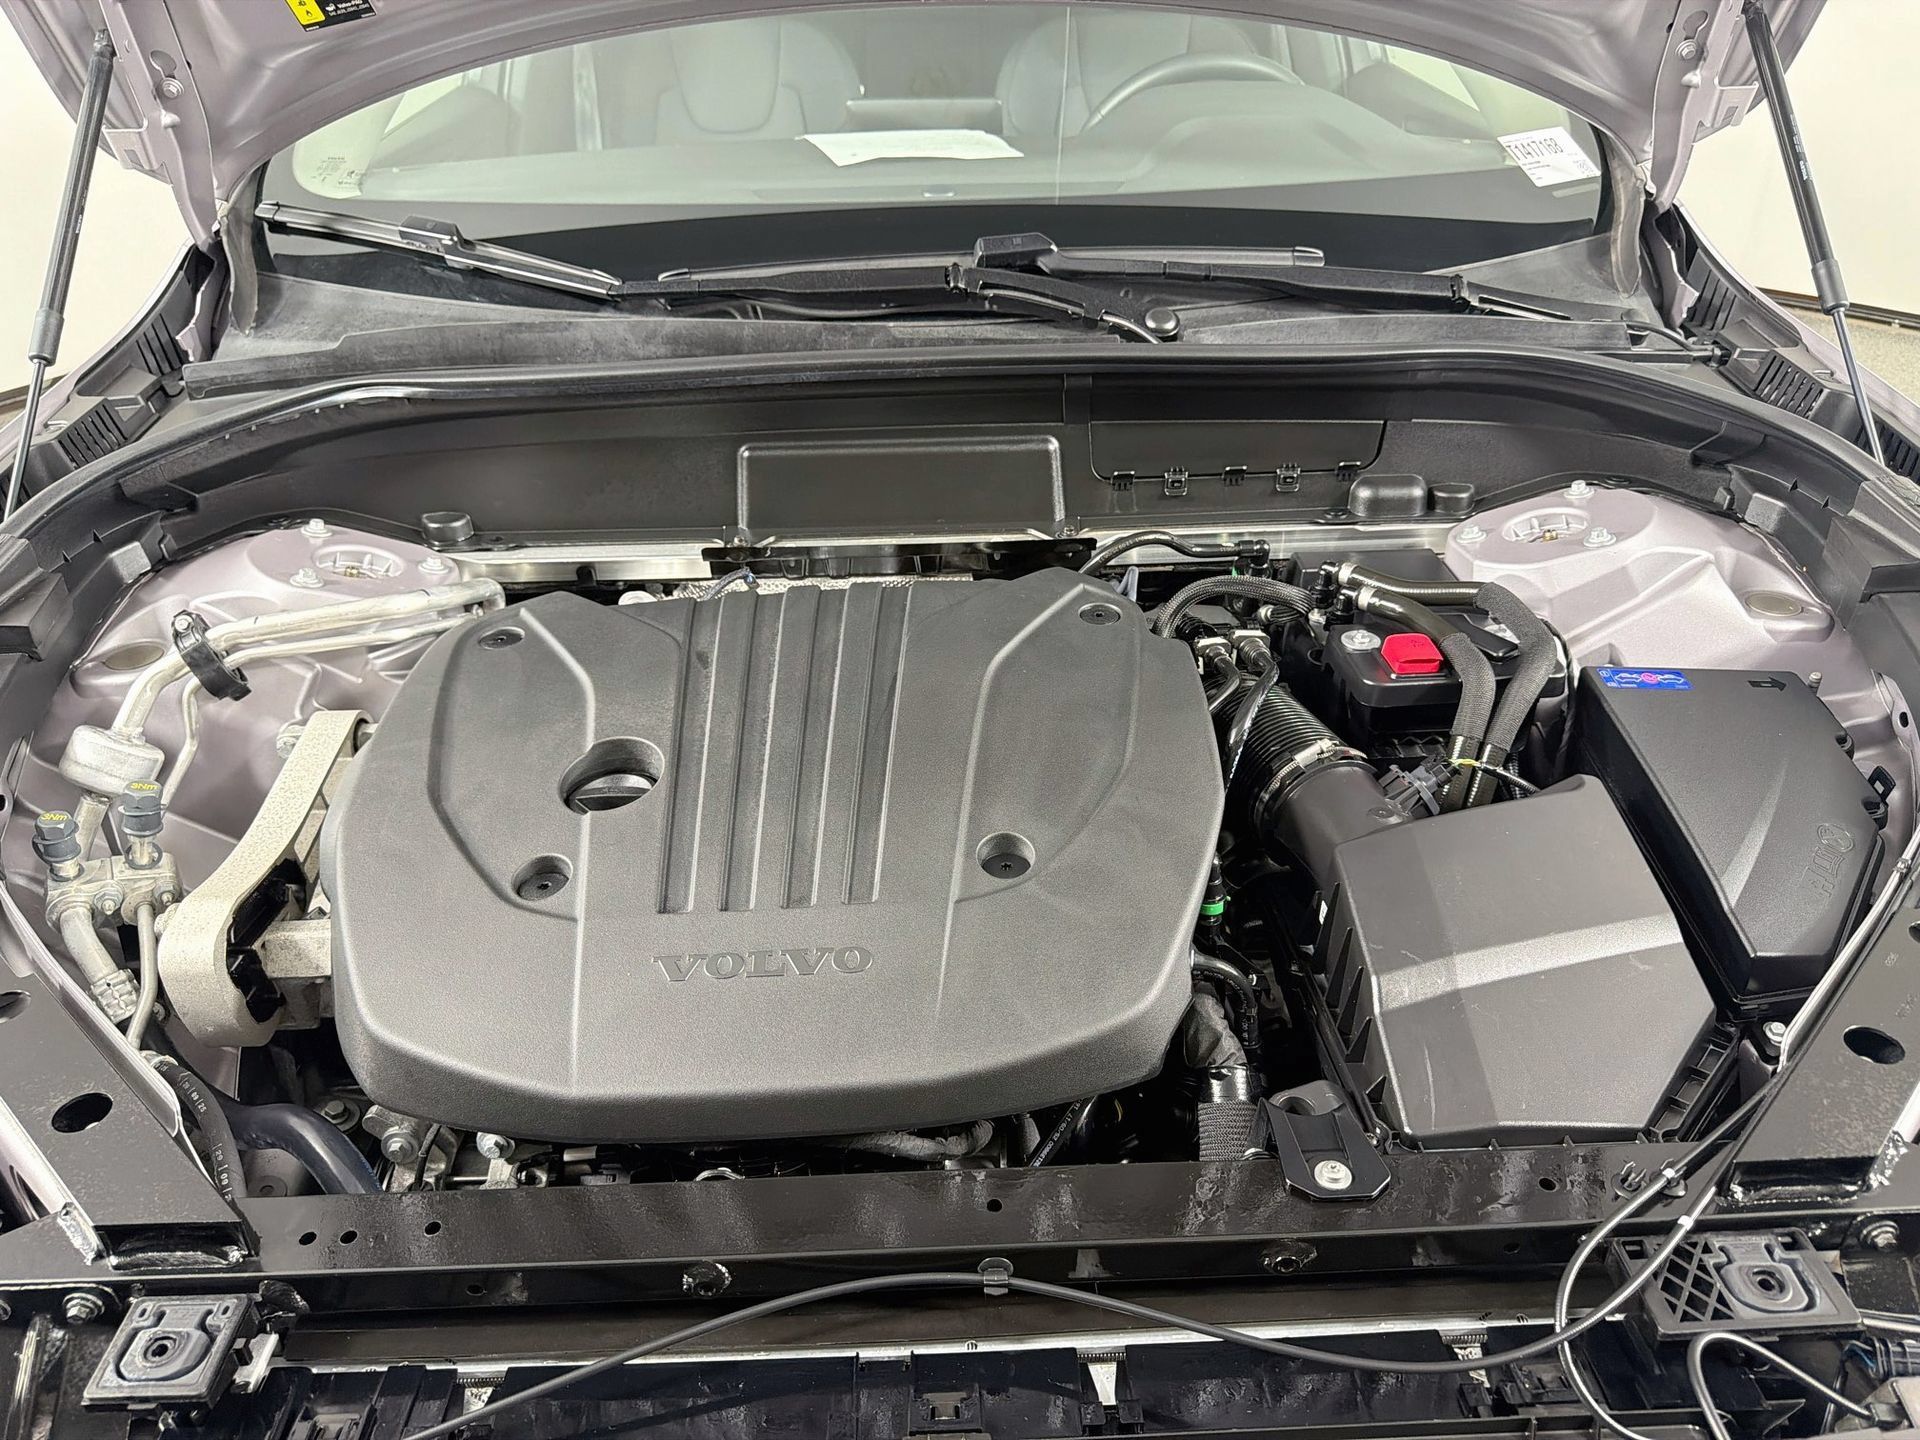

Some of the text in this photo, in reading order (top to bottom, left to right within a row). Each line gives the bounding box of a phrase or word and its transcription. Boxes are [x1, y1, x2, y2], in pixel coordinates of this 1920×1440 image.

[1505, 137, 1564, 161] T1417168
[130, 782, 158, 790] 3Nm
[41, 812, 68, 821] 3Nm
[651, 946, 873, 982] VOLVO
